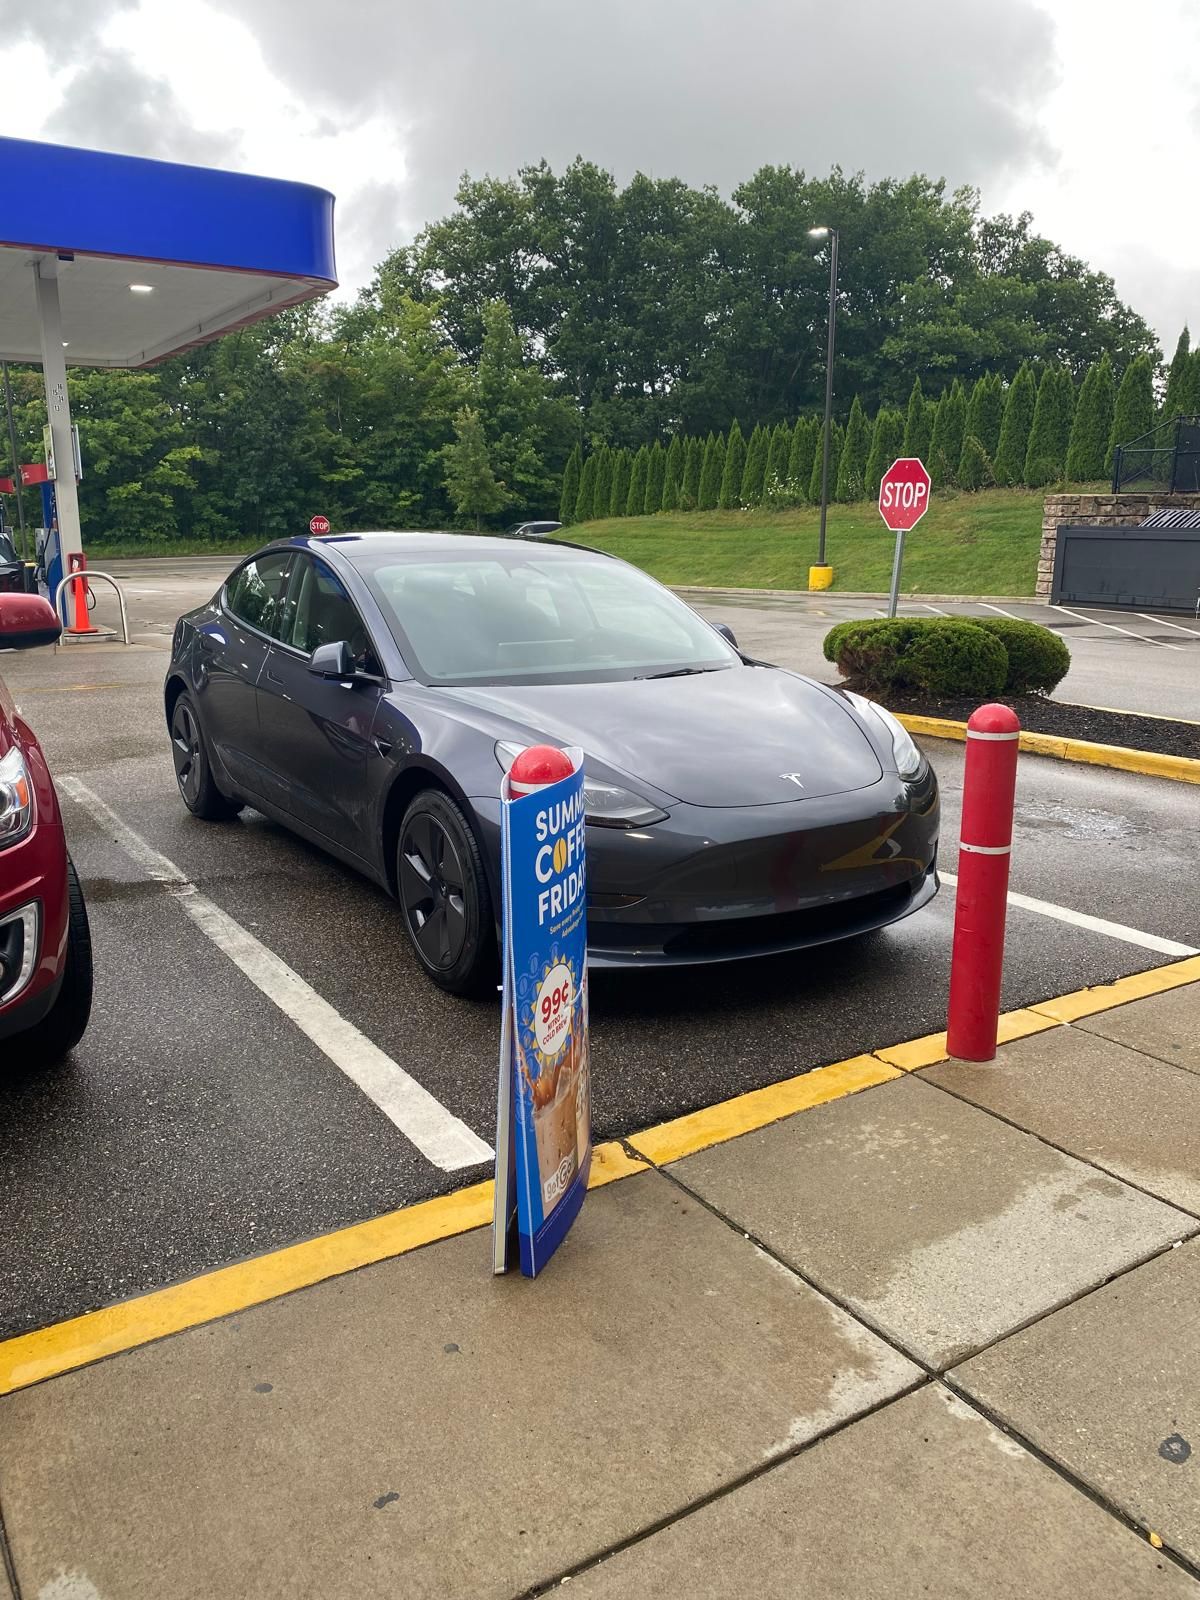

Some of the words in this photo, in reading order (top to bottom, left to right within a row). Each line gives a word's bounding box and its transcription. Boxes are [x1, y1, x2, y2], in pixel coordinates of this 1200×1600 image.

[882, 481, 926, 508] STOP
[311, 521, 329, 530] STOP
[541, 979, 569, 1023] 99¢
[542, 1029, 556, 1045] COLD
